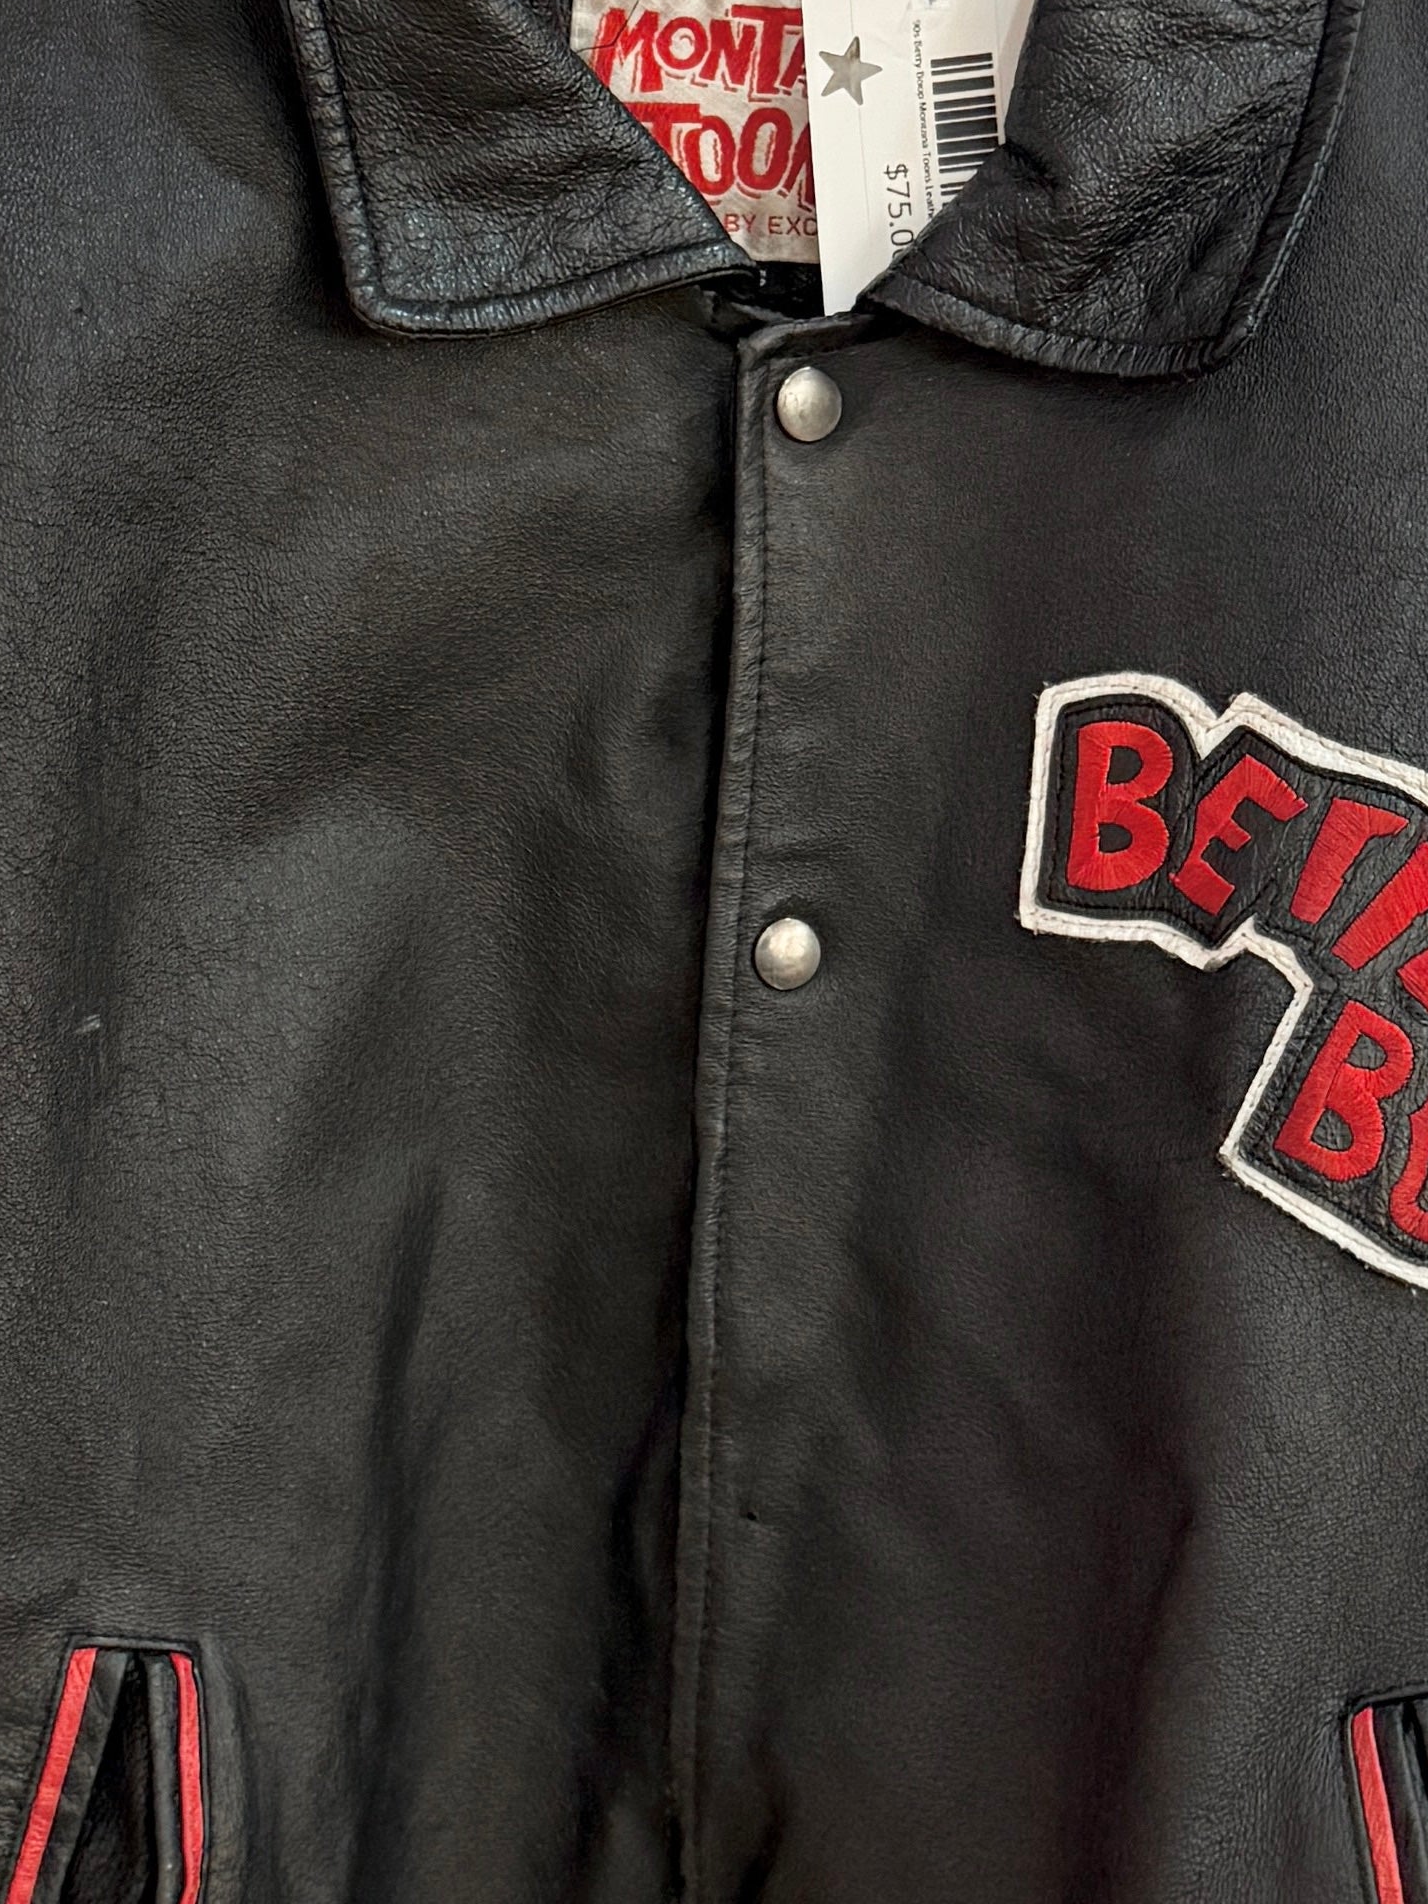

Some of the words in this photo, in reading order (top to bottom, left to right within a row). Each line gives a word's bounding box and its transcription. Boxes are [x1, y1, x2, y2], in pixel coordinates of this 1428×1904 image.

[919, 102, 929, 149] Montana
[922, 151, 932, 184] Toons
[925, 185, 935, 218] Leathe
[724, 213, 756, 234] BY
[768, 215, 819, 236] EXC
